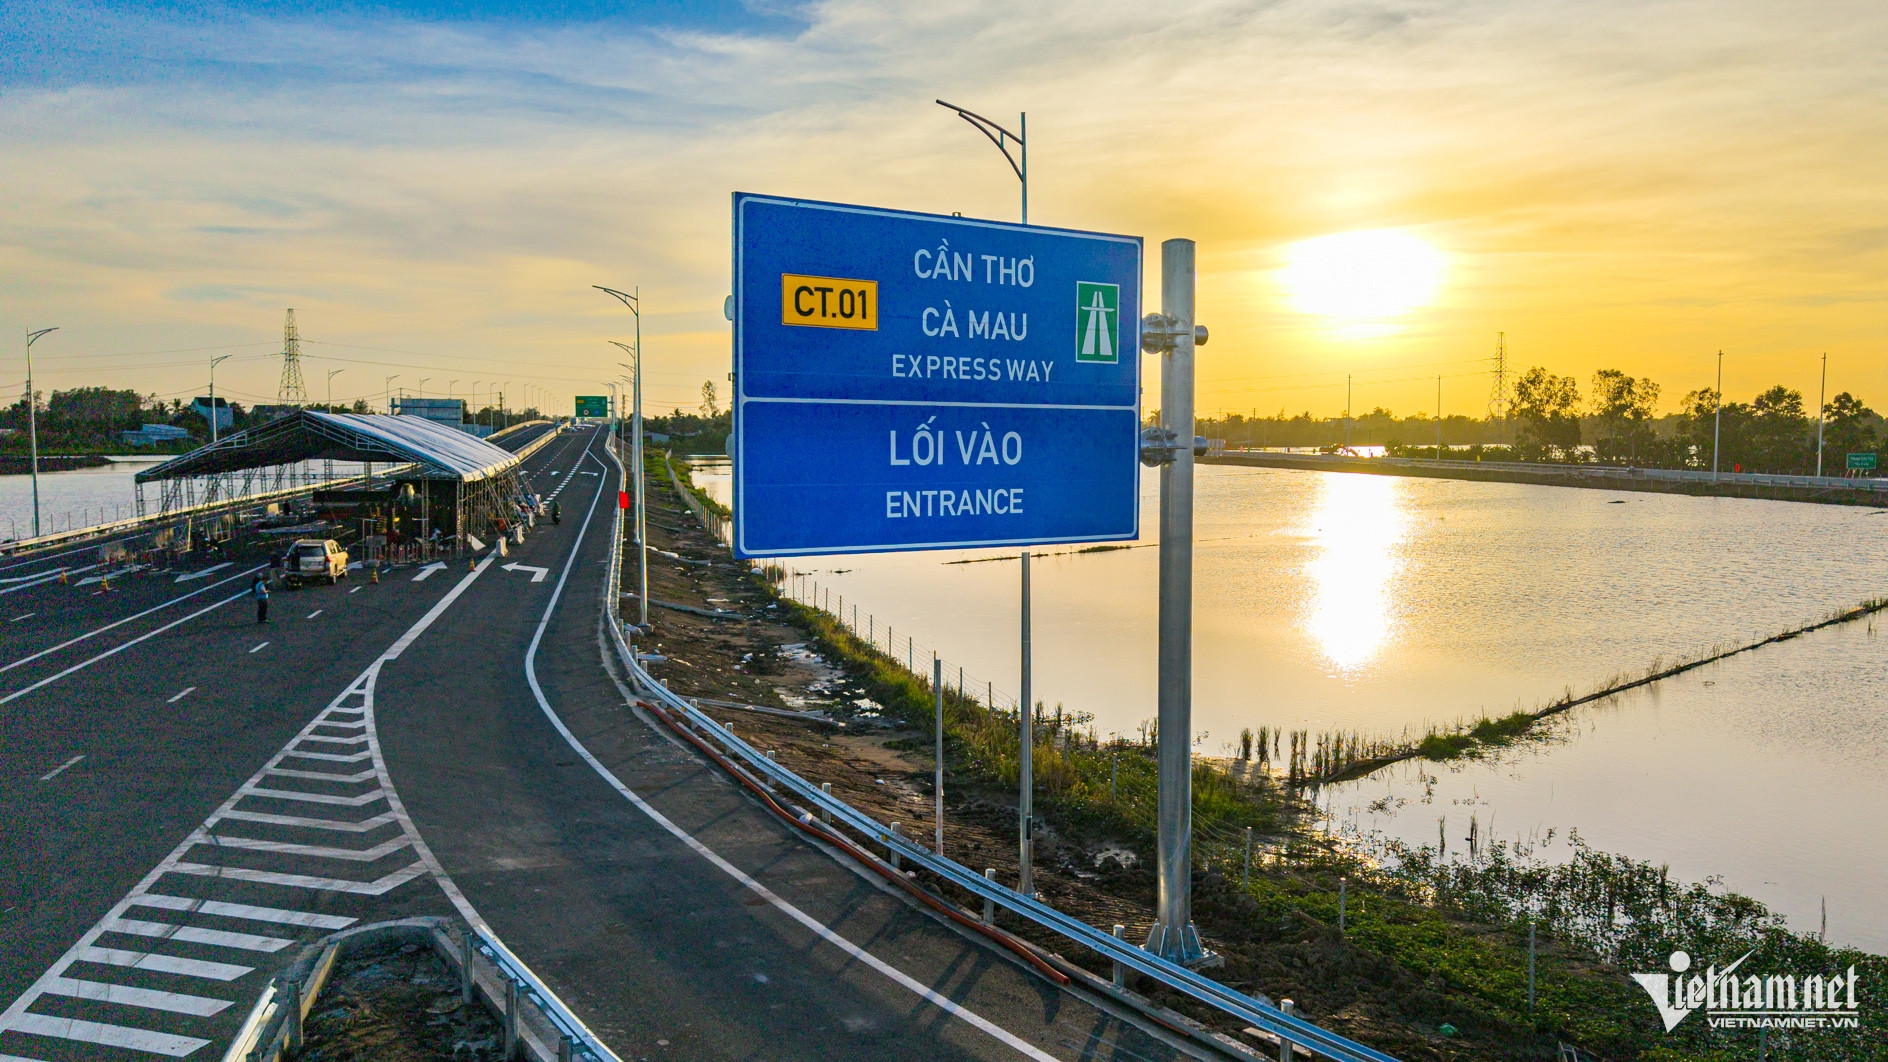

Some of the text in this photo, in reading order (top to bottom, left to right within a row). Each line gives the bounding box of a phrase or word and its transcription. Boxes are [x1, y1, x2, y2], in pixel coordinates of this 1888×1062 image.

[913, 238, 1034, 288] CẦN THƠ
[794, 285, 868, 320] CT.01
[922, 299, 1027, 341] CÀ MAU
[890, 415, 1022, 466] LỐI VÀO
[886, 488, 1024, 518] ENTRANCE
